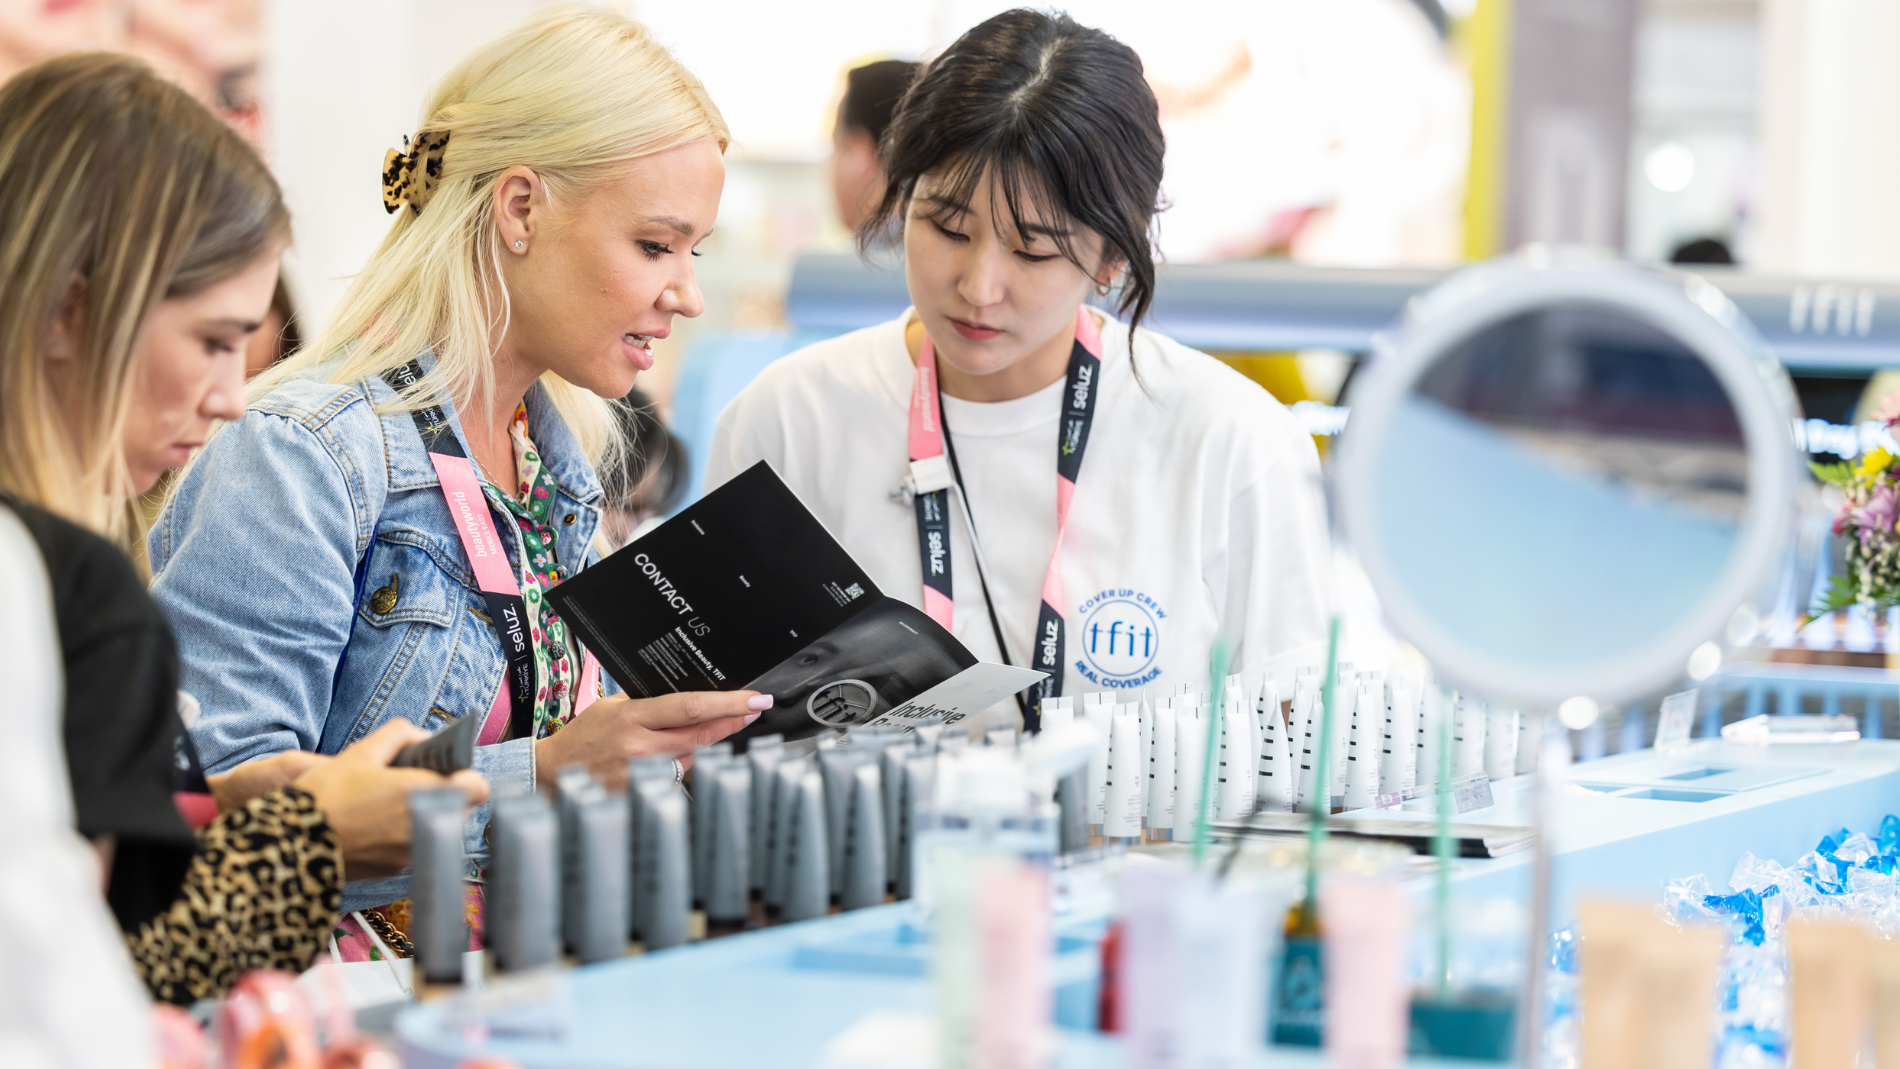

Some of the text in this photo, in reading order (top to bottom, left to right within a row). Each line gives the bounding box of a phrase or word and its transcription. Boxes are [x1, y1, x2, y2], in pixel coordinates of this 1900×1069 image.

[451, 491, 488, 558] beautyworld
[477, 512, 498, 556] MIDDLE EAST
[634, 553, 693, 615] CONTACT
[688, 616, 711, 636] US
[1079, 588, 1167, 619] COVER UP CREW
[674, 626, 698, 652] Inclusive
[712, 667, 727, 682] TFIT
[1089, 620, 1153, 658] tfit
[1074, 660, 1163, 689] REAL COVERAGE
[888, 701, 967, 725] Inclusive
